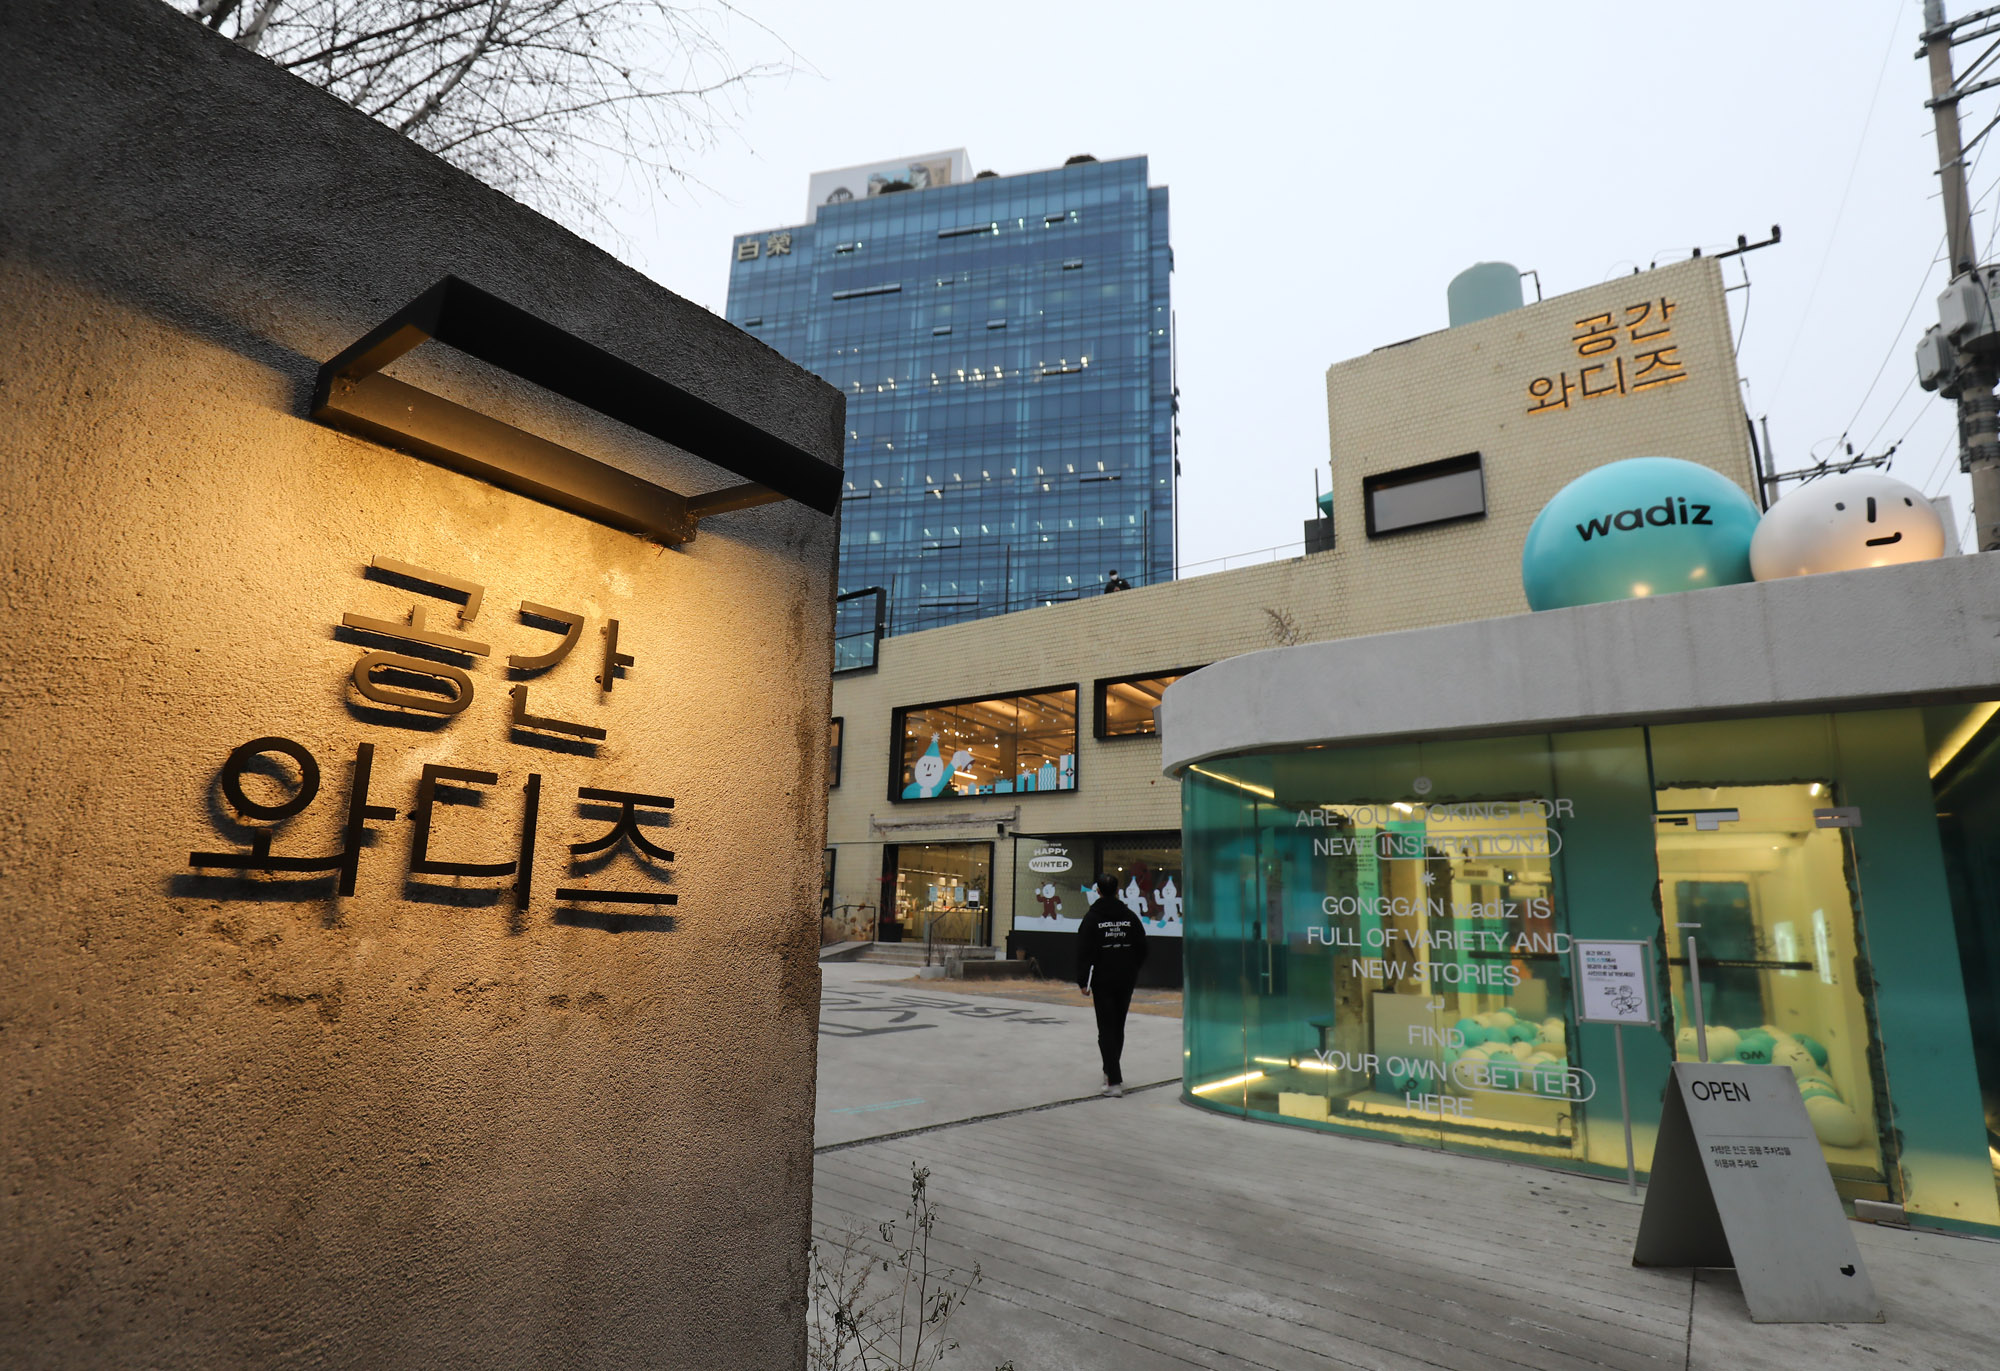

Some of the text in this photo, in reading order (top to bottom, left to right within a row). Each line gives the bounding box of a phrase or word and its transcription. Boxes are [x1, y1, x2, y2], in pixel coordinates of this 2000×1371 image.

[1572, 297, 1676, 356] 공간
[1527, 345, 1687, 414] 와디즈
[1576, 496, 1713, 541] wadiz
[342, 554, 635, 741] 공간
[188, 736, 679, 911] 와디즈
[1296, 798, 1575, 827] ARE YOU LOOKING FOR
[1034, 847, 1068, 856] HAPPY
[1314, 837, 1366, 856] NEW
[1382, 831, 1549, 855] INSPIRATION?
[1322, 896, 1551, 919] GONGGAN wadiz IS
[1307, 926, 1361, 947] FULL
[1366, 928, 1398, 948] OF
[1404, 929, 1510, 952] VARIETY
[1515, 932, 1573, 954] AND
[1352, 959, 1521, 986] NEW STORIES
[1408, 1025, 1465, 1049] FIND
[1314, 1049, 1380, 1074] YOUR
[1386, 1056, 1447, 1082] OWN
[1692, 1080, 1751, 1102] OPEN
[1406, 1092, 1474, 1118] HERE
[1710, 1145, 1732, 1155] 차량은
[1732, 1146, 1747, 1155] 인근
[1763, 1146, 1792, 1156] 주차장을
[1737, 1159, 1759, 1168] 주세요
